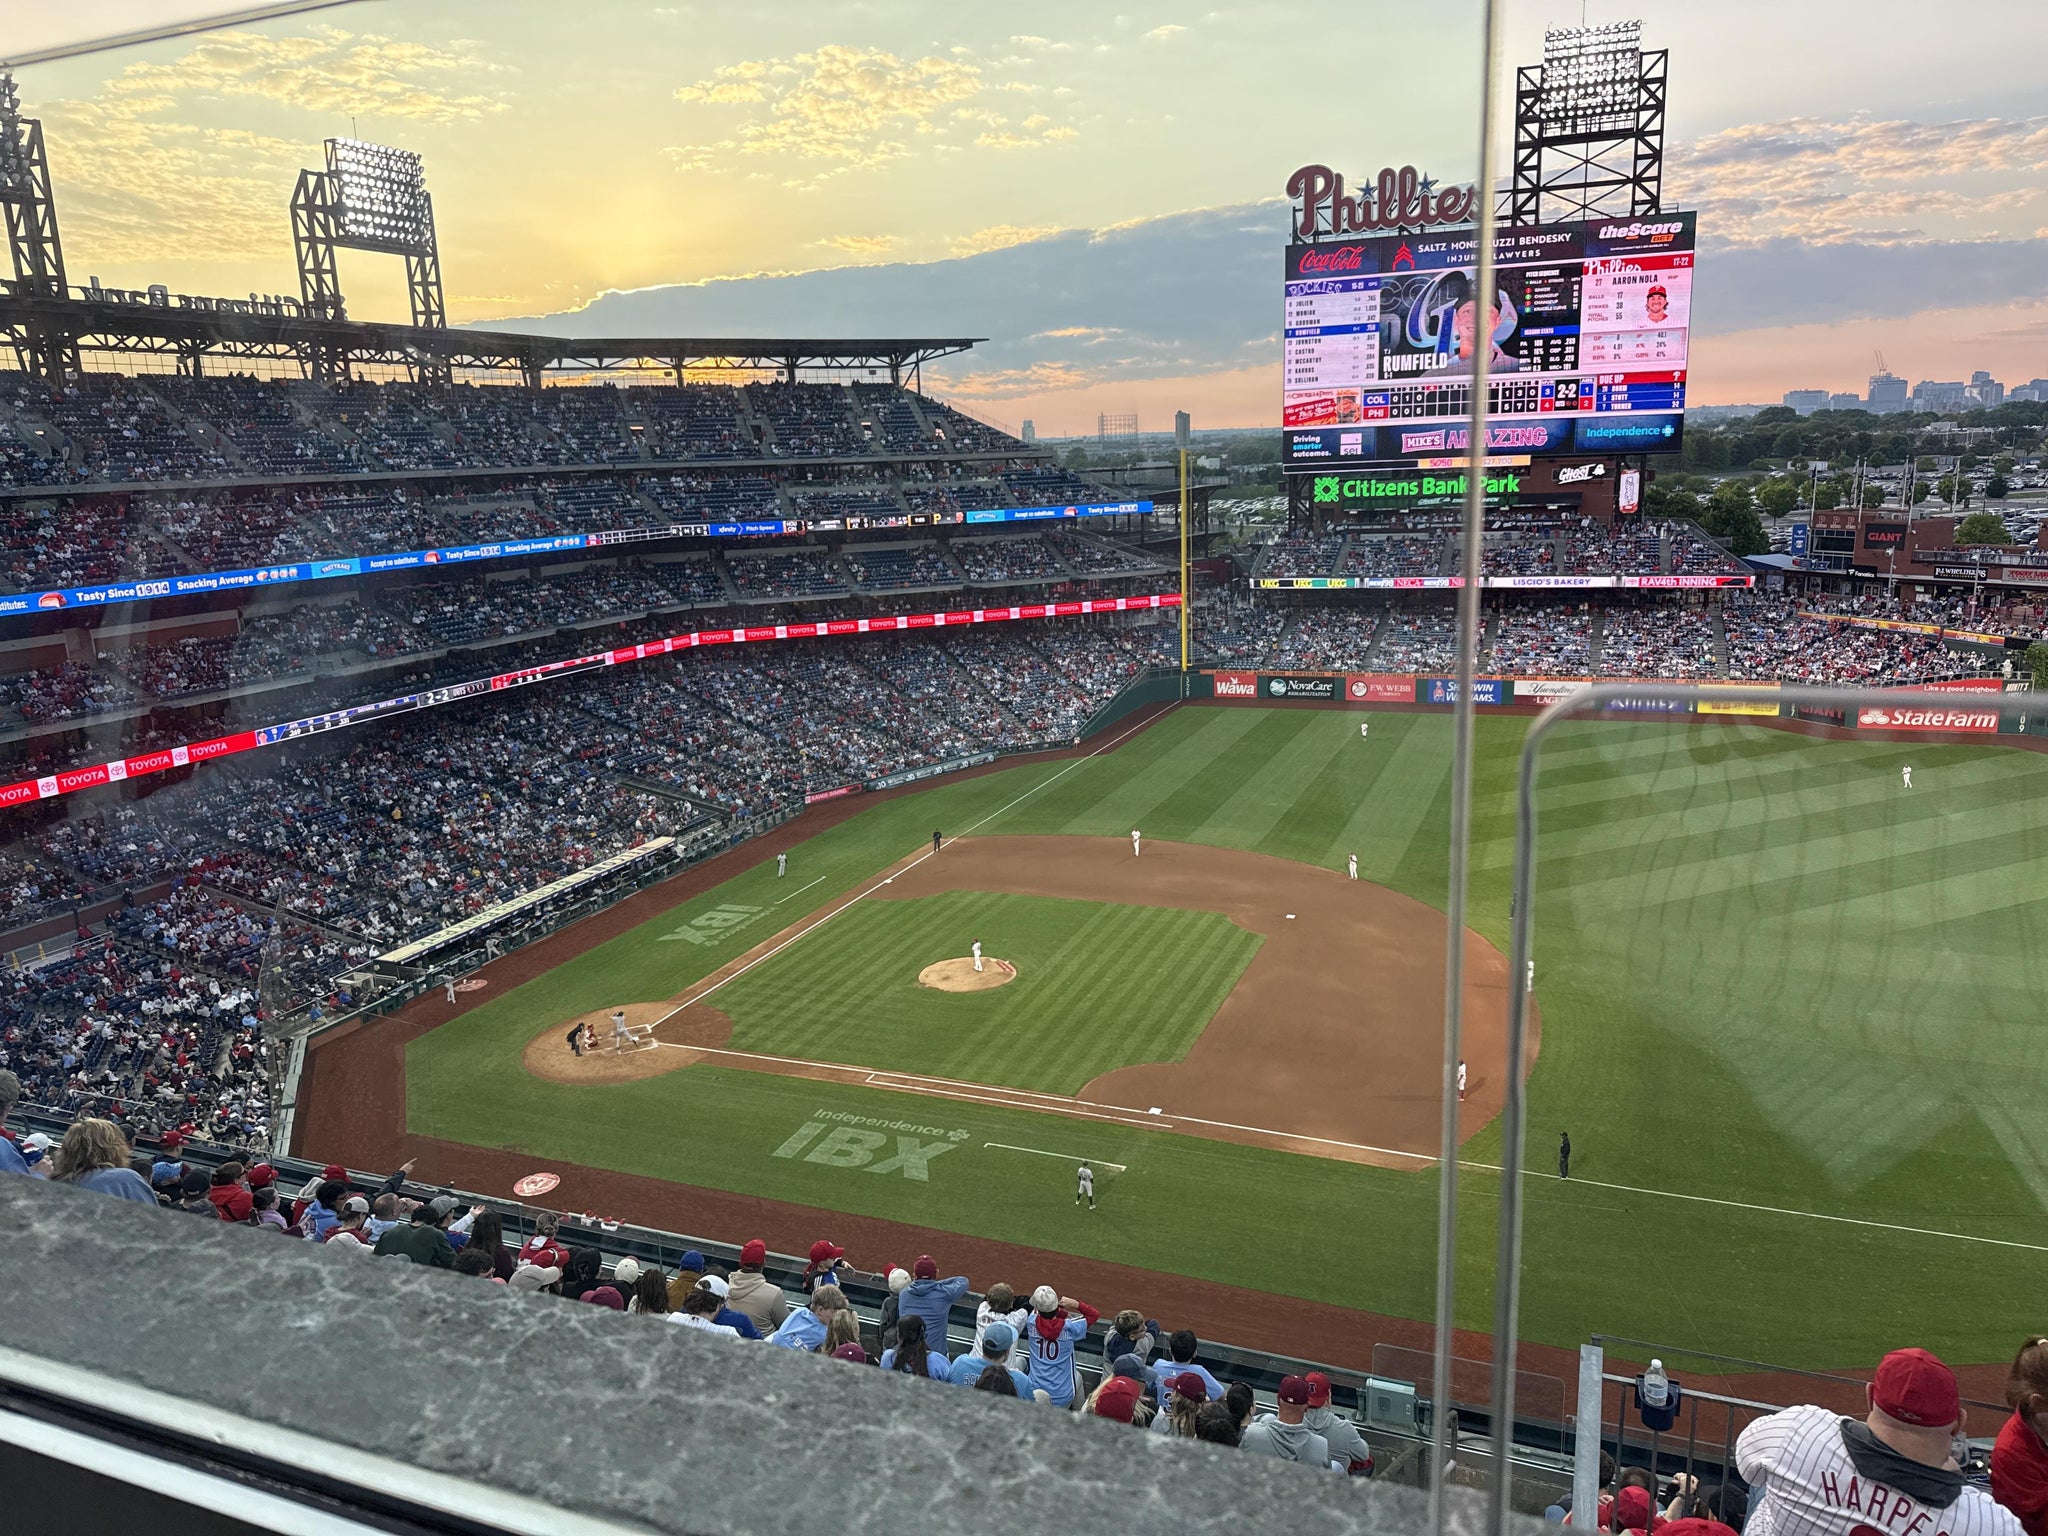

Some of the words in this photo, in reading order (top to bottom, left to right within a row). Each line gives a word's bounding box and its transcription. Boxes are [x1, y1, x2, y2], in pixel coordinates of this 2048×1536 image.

[1599, 222, 1683, 239] theScore
[1418, 241, 1447, 254] SALTZ
[1519, 233, 1572, 246] BENDESKY
[1493, 250, 1541, 260] LAWYERS
[1674, 257, 1689, 266] 17-22
[1612, 277, 1636, 285] AARON
[1639, 274, 1658, 283] NOLA
[1289, 281, 1342, 297] ROCKIES
[1617, 291, 1624, 299] 17
[1616, 301, 1624, 309] 38
[1616, 312, 1623, 320] 55
[1383, 352, 1448, 372] RUMFIELD
[1600, 376, 1613, 384] DUE
[1614, 375, 1625, 383] UP
[1366, 395, 1385, 405] COL
[1392, 395, 1398, 403] 0
[1405, 394, 1410, 402] 1
[1416, 393, 1422, 402] 0
[1505, 389, 1510, 397] 1
[1517, 388, 1523, 397] 3
[1529, 388, 1536, 396] 0
[1544, 388, 1551, 396] 3
[1557, 384, 1577, 399] 2-2
[1584, 386, 1589, 394] 1
[1368, 409, 1385, 418] PHI
[1392, 408, 1398, 416] 0
[1416, 407, 1422, 415] 5
[1504, 402, 1510, 410] 5
[1516, 401, 1523, 410] 7
[1528, 401, 1535, 410] 0
[1543, 401, 1550, 409] 4
[1583, 399, 1589, 407] 2
[1586, 426, 1661, 439] Independence
[1293, 435, 1321, 444] Driving
[1407, 434, 1441, 448] MIKE'S
[1293, 443, 1323, 451] smarter
[1293, 451, 1332, 459] outcomes.
[1558, 463, 1597, 485] GHOST
[1343, 479, 1419, 498] Citizens
[1422, 475, 1470, 496] Bank
[1867, 532, 1903, 542] GIANT
[445, 551, 463, 561] Tasty
[463, 549, 481, 558] Since
[505, 543, 531, 553] Snacking
[531, 541, 553, 550] Average
[1854, 570, 1876, 579] Fanatics
[1260, 578, 1280, 588] UKG
[1293, 578, 1313, 588] UKG
[1327, 578, 1347, 588] UKG
[1397, 579, 1420, 588] NECA
[1513, 578, 1551, 586] LISCIO'S
[1554, 578, 1591, 586] BAKERY
[1641, 577, 1678, 587] RAV4th
[1679, 577, 1717, 587] INNING
[75, 590, 106, 603] Tasty
[107, 587, 136, 598] Since
[136, 581, 170, 597] 1914
[177, 578, 218, 591] Snacking
[218, 574, 254, 586] Average
[702, 633, 730, 641] TOYOTA
[747, 630, 775, 638] TOYOTA
[788, 626, 815, 635] TOYOTA
[829, 623, 855, 631] TOYOTA
[870, 620, 896, 628] TOYOTA
[909, 617, 934, 625] TOYOTA
[946, 614, 970, 622] TOYOTA
[985, 611, 1009, 619] TOYOTA
[1057, 604, 1080, 612] TOYOTA
[1216, 680, 1255, 695] Wawa
[1288, 680, 1333, 692] NovaCare
[1391, 684, 1412, 693] WEBB
[426, 690, 450, 705] 2-2
[453, 687, 467, 697] OUTS
[61, 770, 106, 788] TOYOTA
[129, 755, 170, 772] TOYOTA
[191, 742, 228, 758] TOYOTA
[813, 1108, 945, 1136] Independence
[772, 1121, 959, 1182] IBX
[1036, 1339, 1060, 1361] 10
[1821, 1470, 1950, 1536] HARPE
